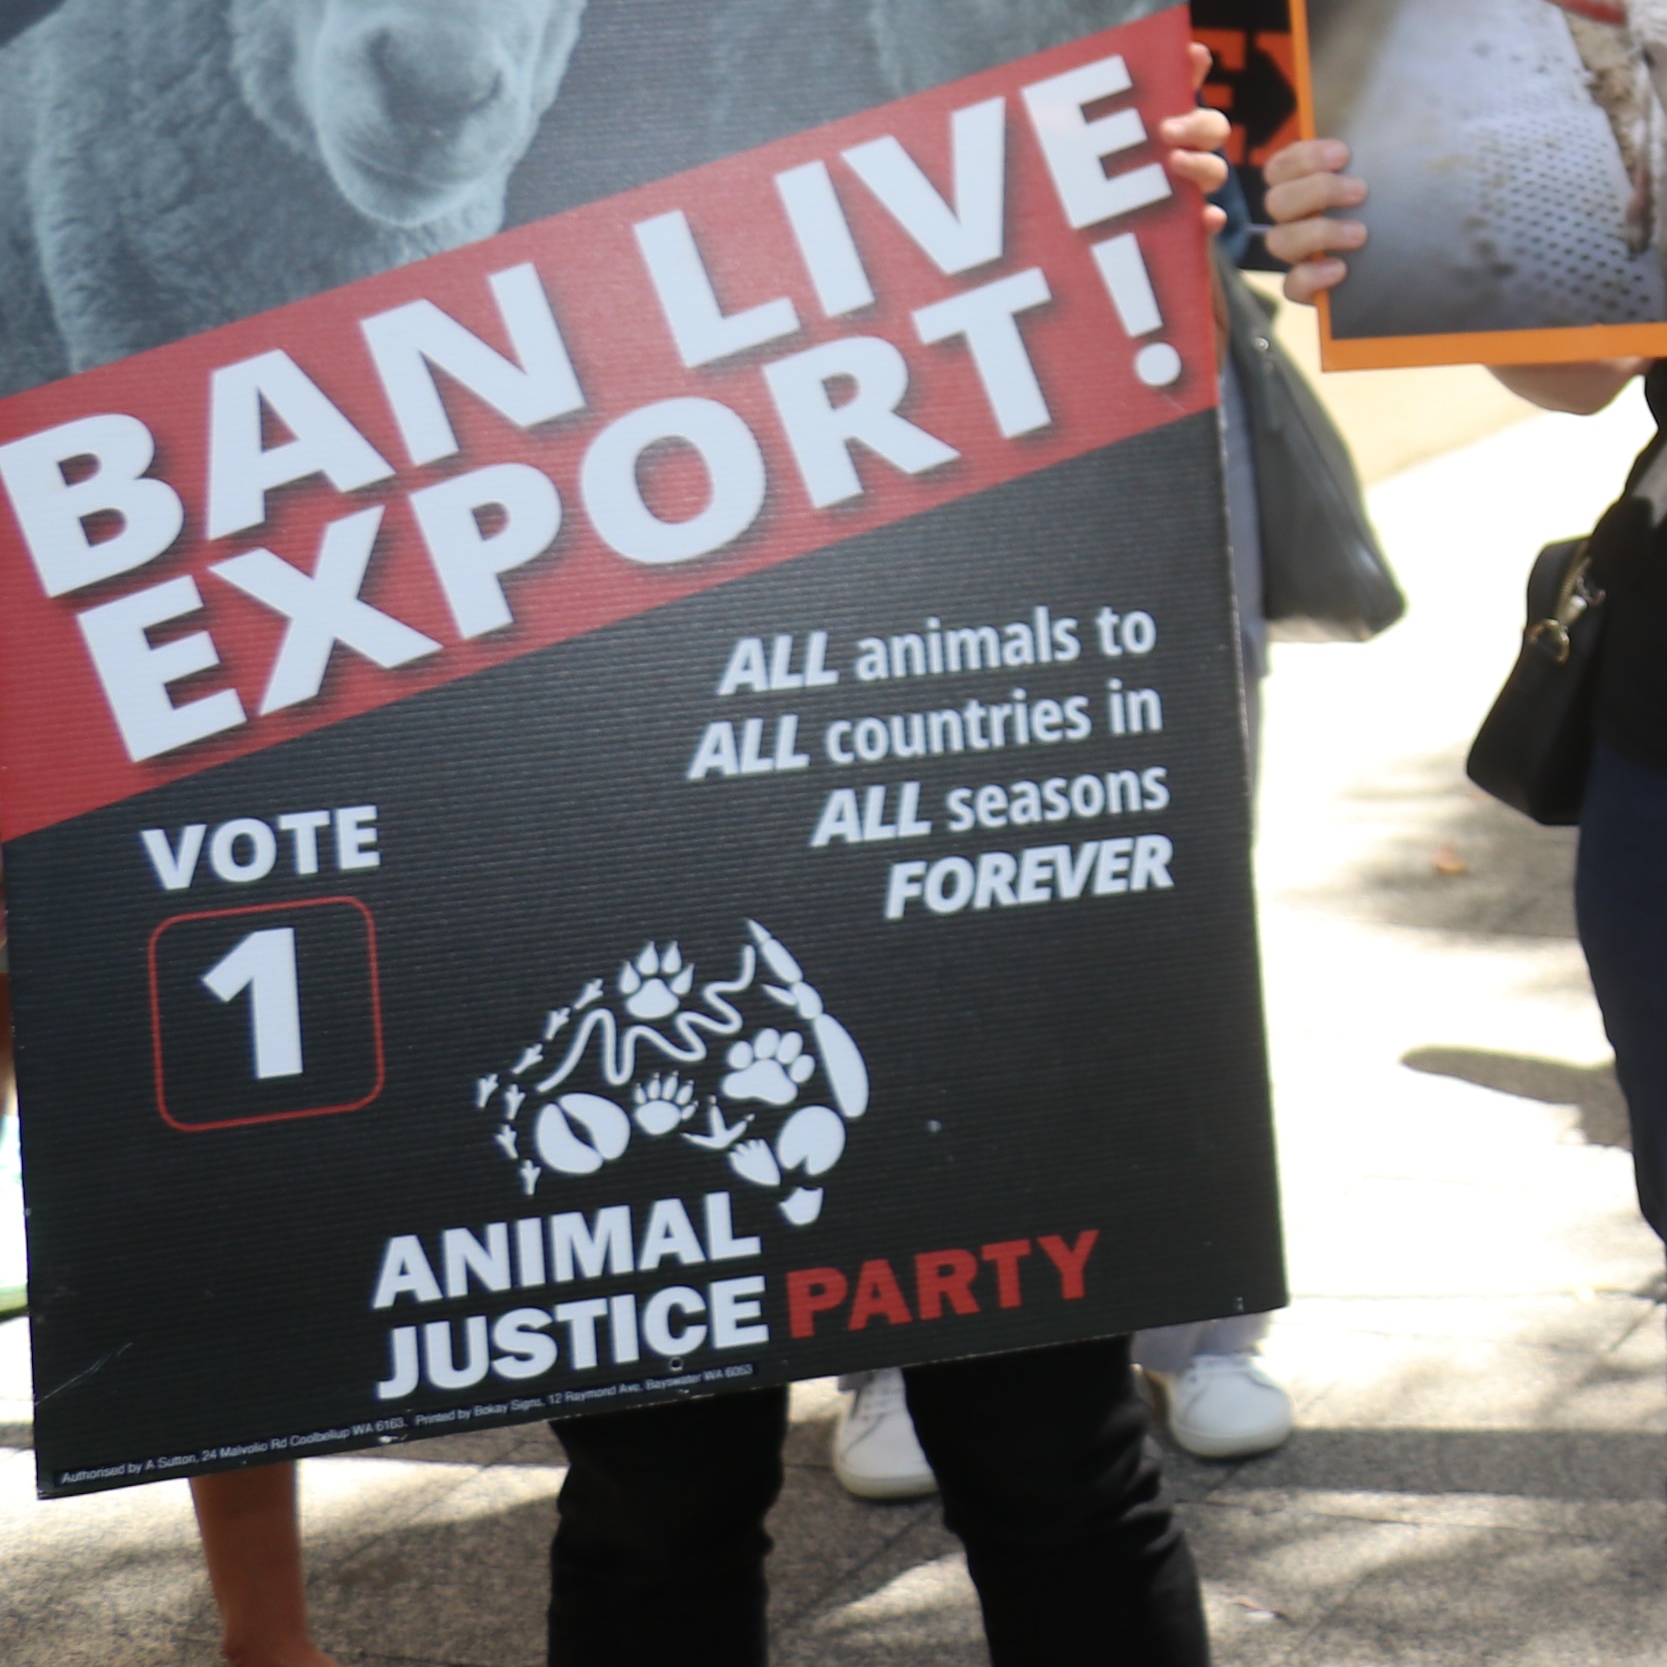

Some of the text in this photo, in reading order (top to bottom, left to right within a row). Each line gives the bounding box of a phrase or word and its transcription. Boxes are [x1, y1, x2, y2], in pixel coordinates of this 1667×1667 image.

[0, 263, 587, 598] BAN
[634, 55, 1171, 368] LIVE
[78, 234, 1182, 764] EXPORT!
[717, 606, 1157, 695] ALL animals to
[687, 680, 1162, 779] ALL countries in
[140, 805, 380, 891] VOTE
[810, 766, 1169, 846] ALL seasons
[885, 834, 1174, 919] FOREVER
[200, 927, 303, 1081] 1
[373, 1193, 761, 1311] ANIMAL
[376, 1230, 1100, 1400] JUSTICE PARTY
[61, 1463, 125, 1484] Authorised
[127, 1461, 142, 1474] by
[144, 1460, 154, 1470] A
[202, 1450, 218, 1461] 24
[271, 1438, 287, 1450] Rd
[352, 1422, 373, 1435] WA
[415, 1410, 455, 1425] Printed
[458, 1408, 471, 1420] by
[549, 1392, 563, 1404] 12
[564, 1385, 616, 1402] Raymond
